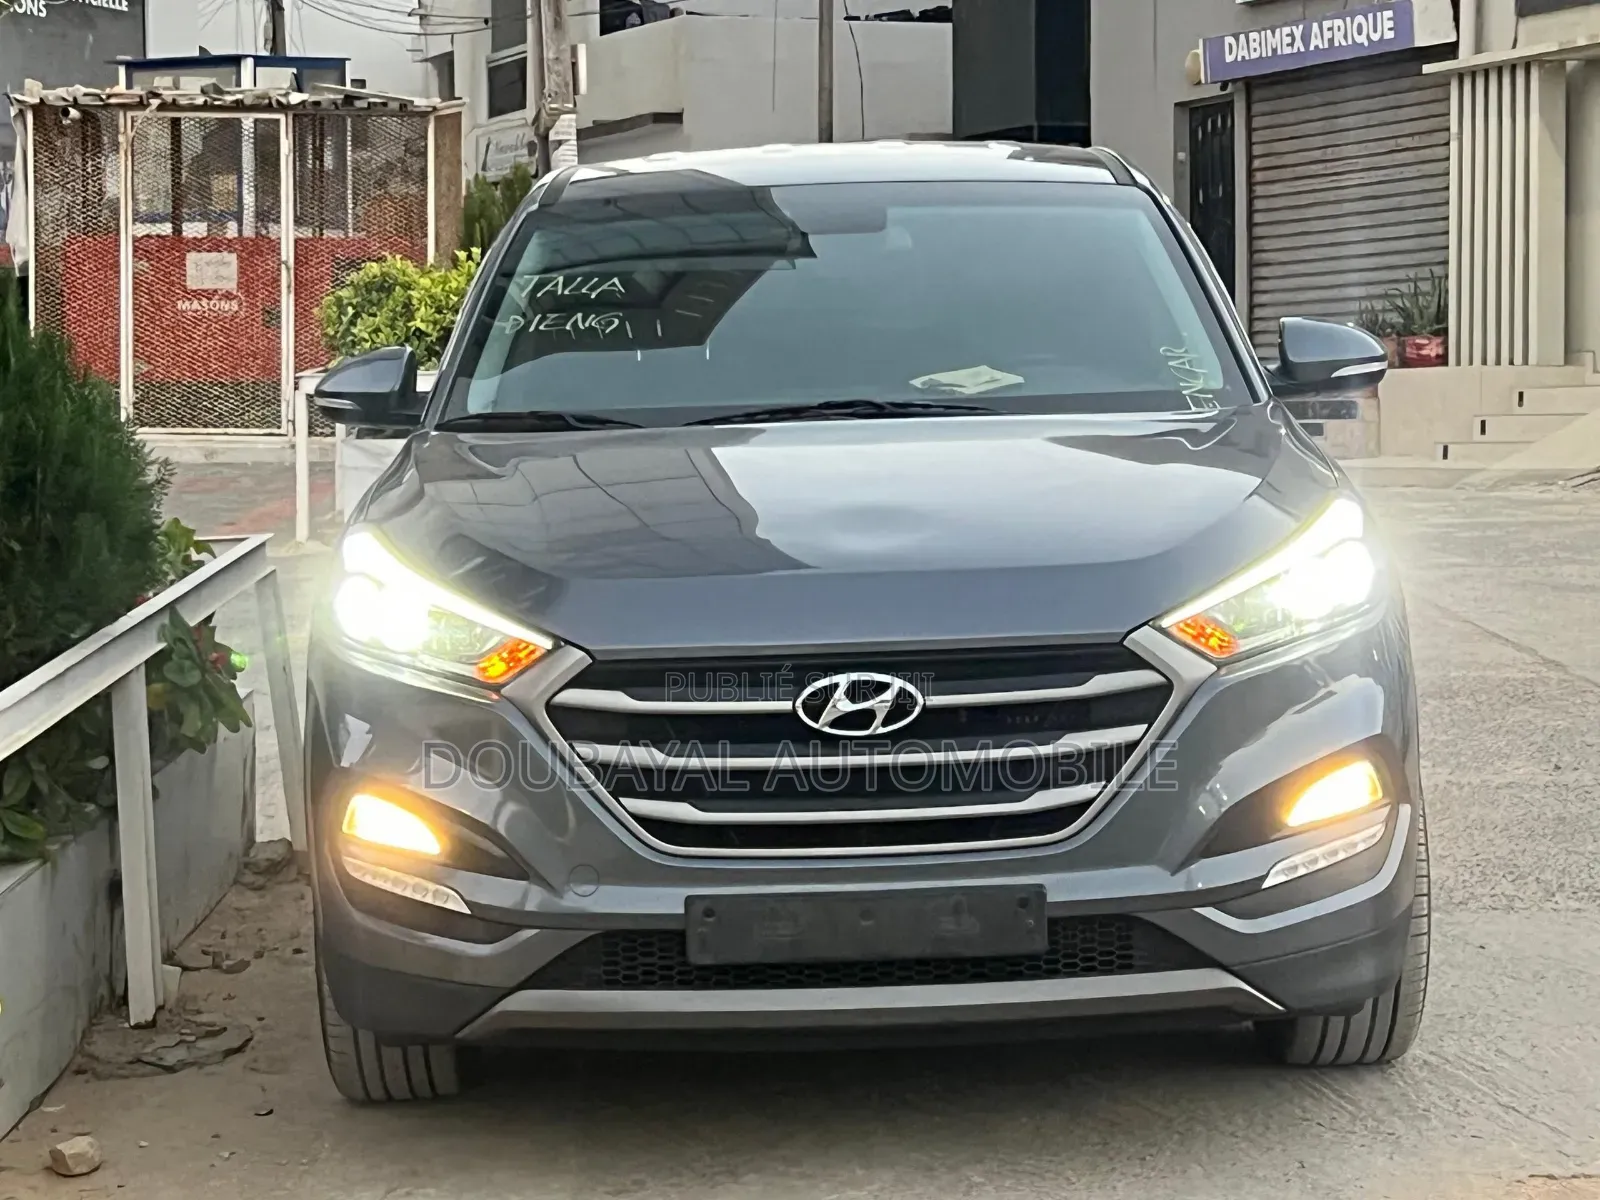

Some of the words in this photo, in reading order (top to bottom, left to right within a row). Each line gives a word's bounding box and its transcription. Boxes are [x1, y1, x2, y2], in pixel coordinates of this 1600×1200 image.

[1224, 24, 1305, 63] DABIMEX
[1309, 10, 1395, 50] AFRIQUE
[521, 274, 626, 299] TALLA
